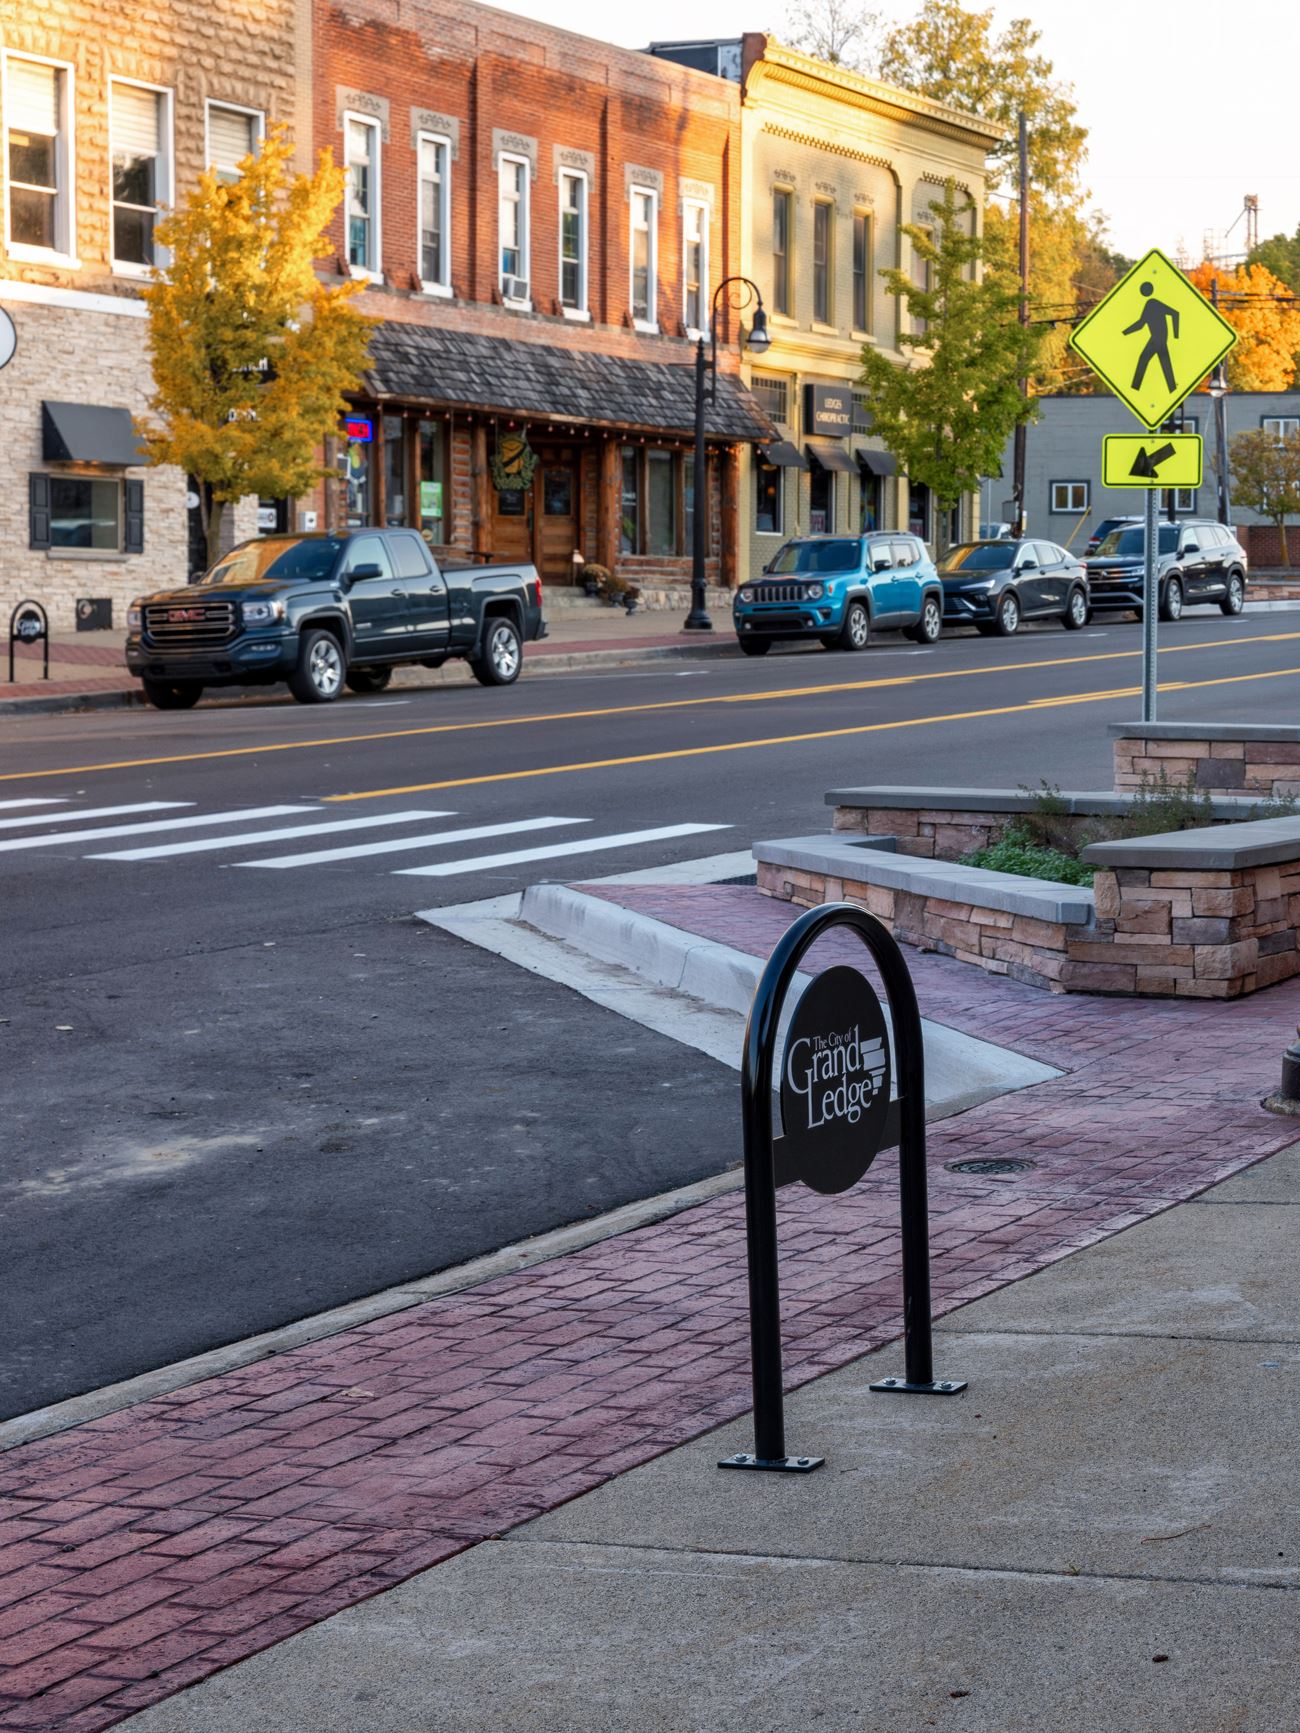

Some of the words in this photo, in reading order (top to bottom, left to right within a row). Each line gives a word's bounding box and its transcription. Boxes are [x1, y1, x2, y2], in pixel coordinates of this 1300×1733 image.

[168, 609, 206, 622] GMC
[787, 1023, 862, 1095] Grand
[813, 1036, 828, 1051] The
[828, 1031, 844, 1047] City
[844, 1027, 852, 1043] of
[804, 1067, 872, 1129] Ledge
